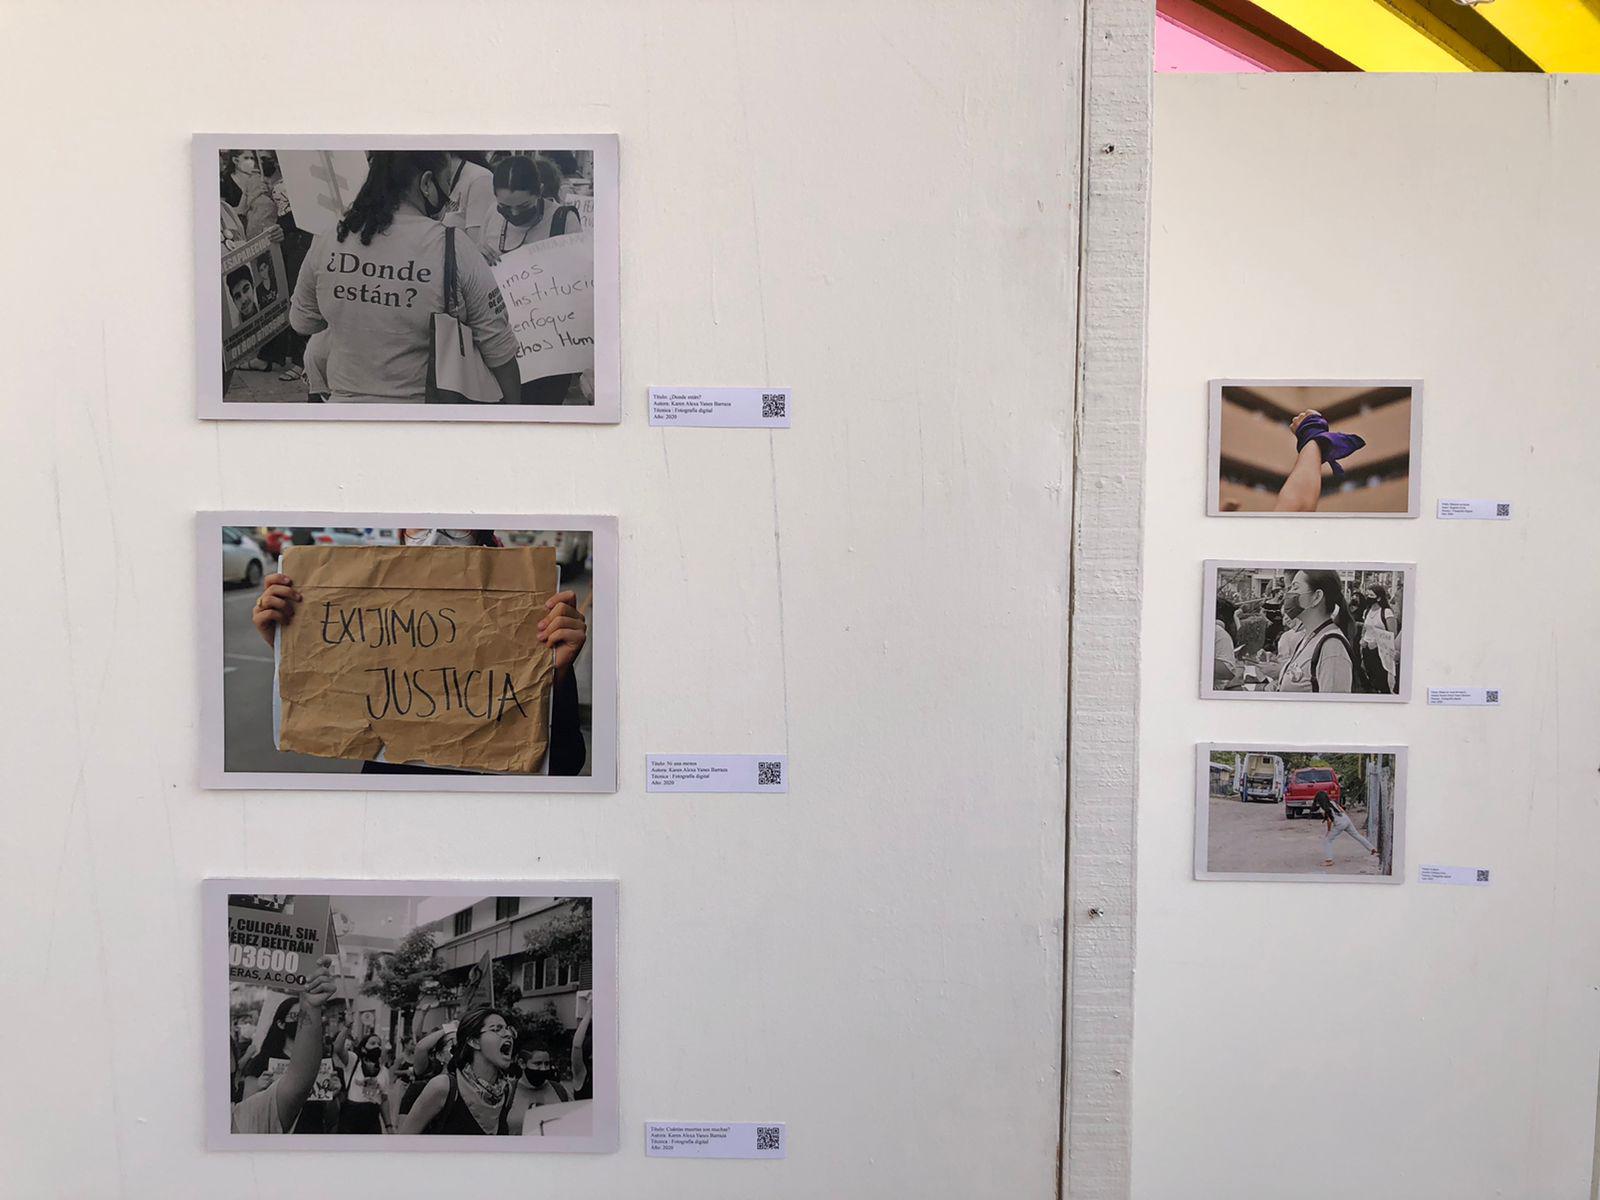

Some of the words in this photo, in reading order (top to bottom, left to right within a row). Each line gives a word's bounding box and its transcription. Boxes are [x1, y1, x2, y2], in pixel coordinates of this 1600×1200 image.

[326, 252, 432, 283] ¿Donde
[333, 283, 418, 308] están?
[513, 307, 576, 335] enfoque
[321, 600, 457, 648] EXIJIMOS
[364, 666, 529, 722] JUSTICIA
[228, 929, 259, 946] ÉREZ
[261, 934, 314, 954] BELTRÁN
[237, 918, 293, 939] CULICÁN,
[295, 926, 320, 942] SIN.
[229, 944, 299, 974] 03600
[263, 972, 284, 983] A.C.
